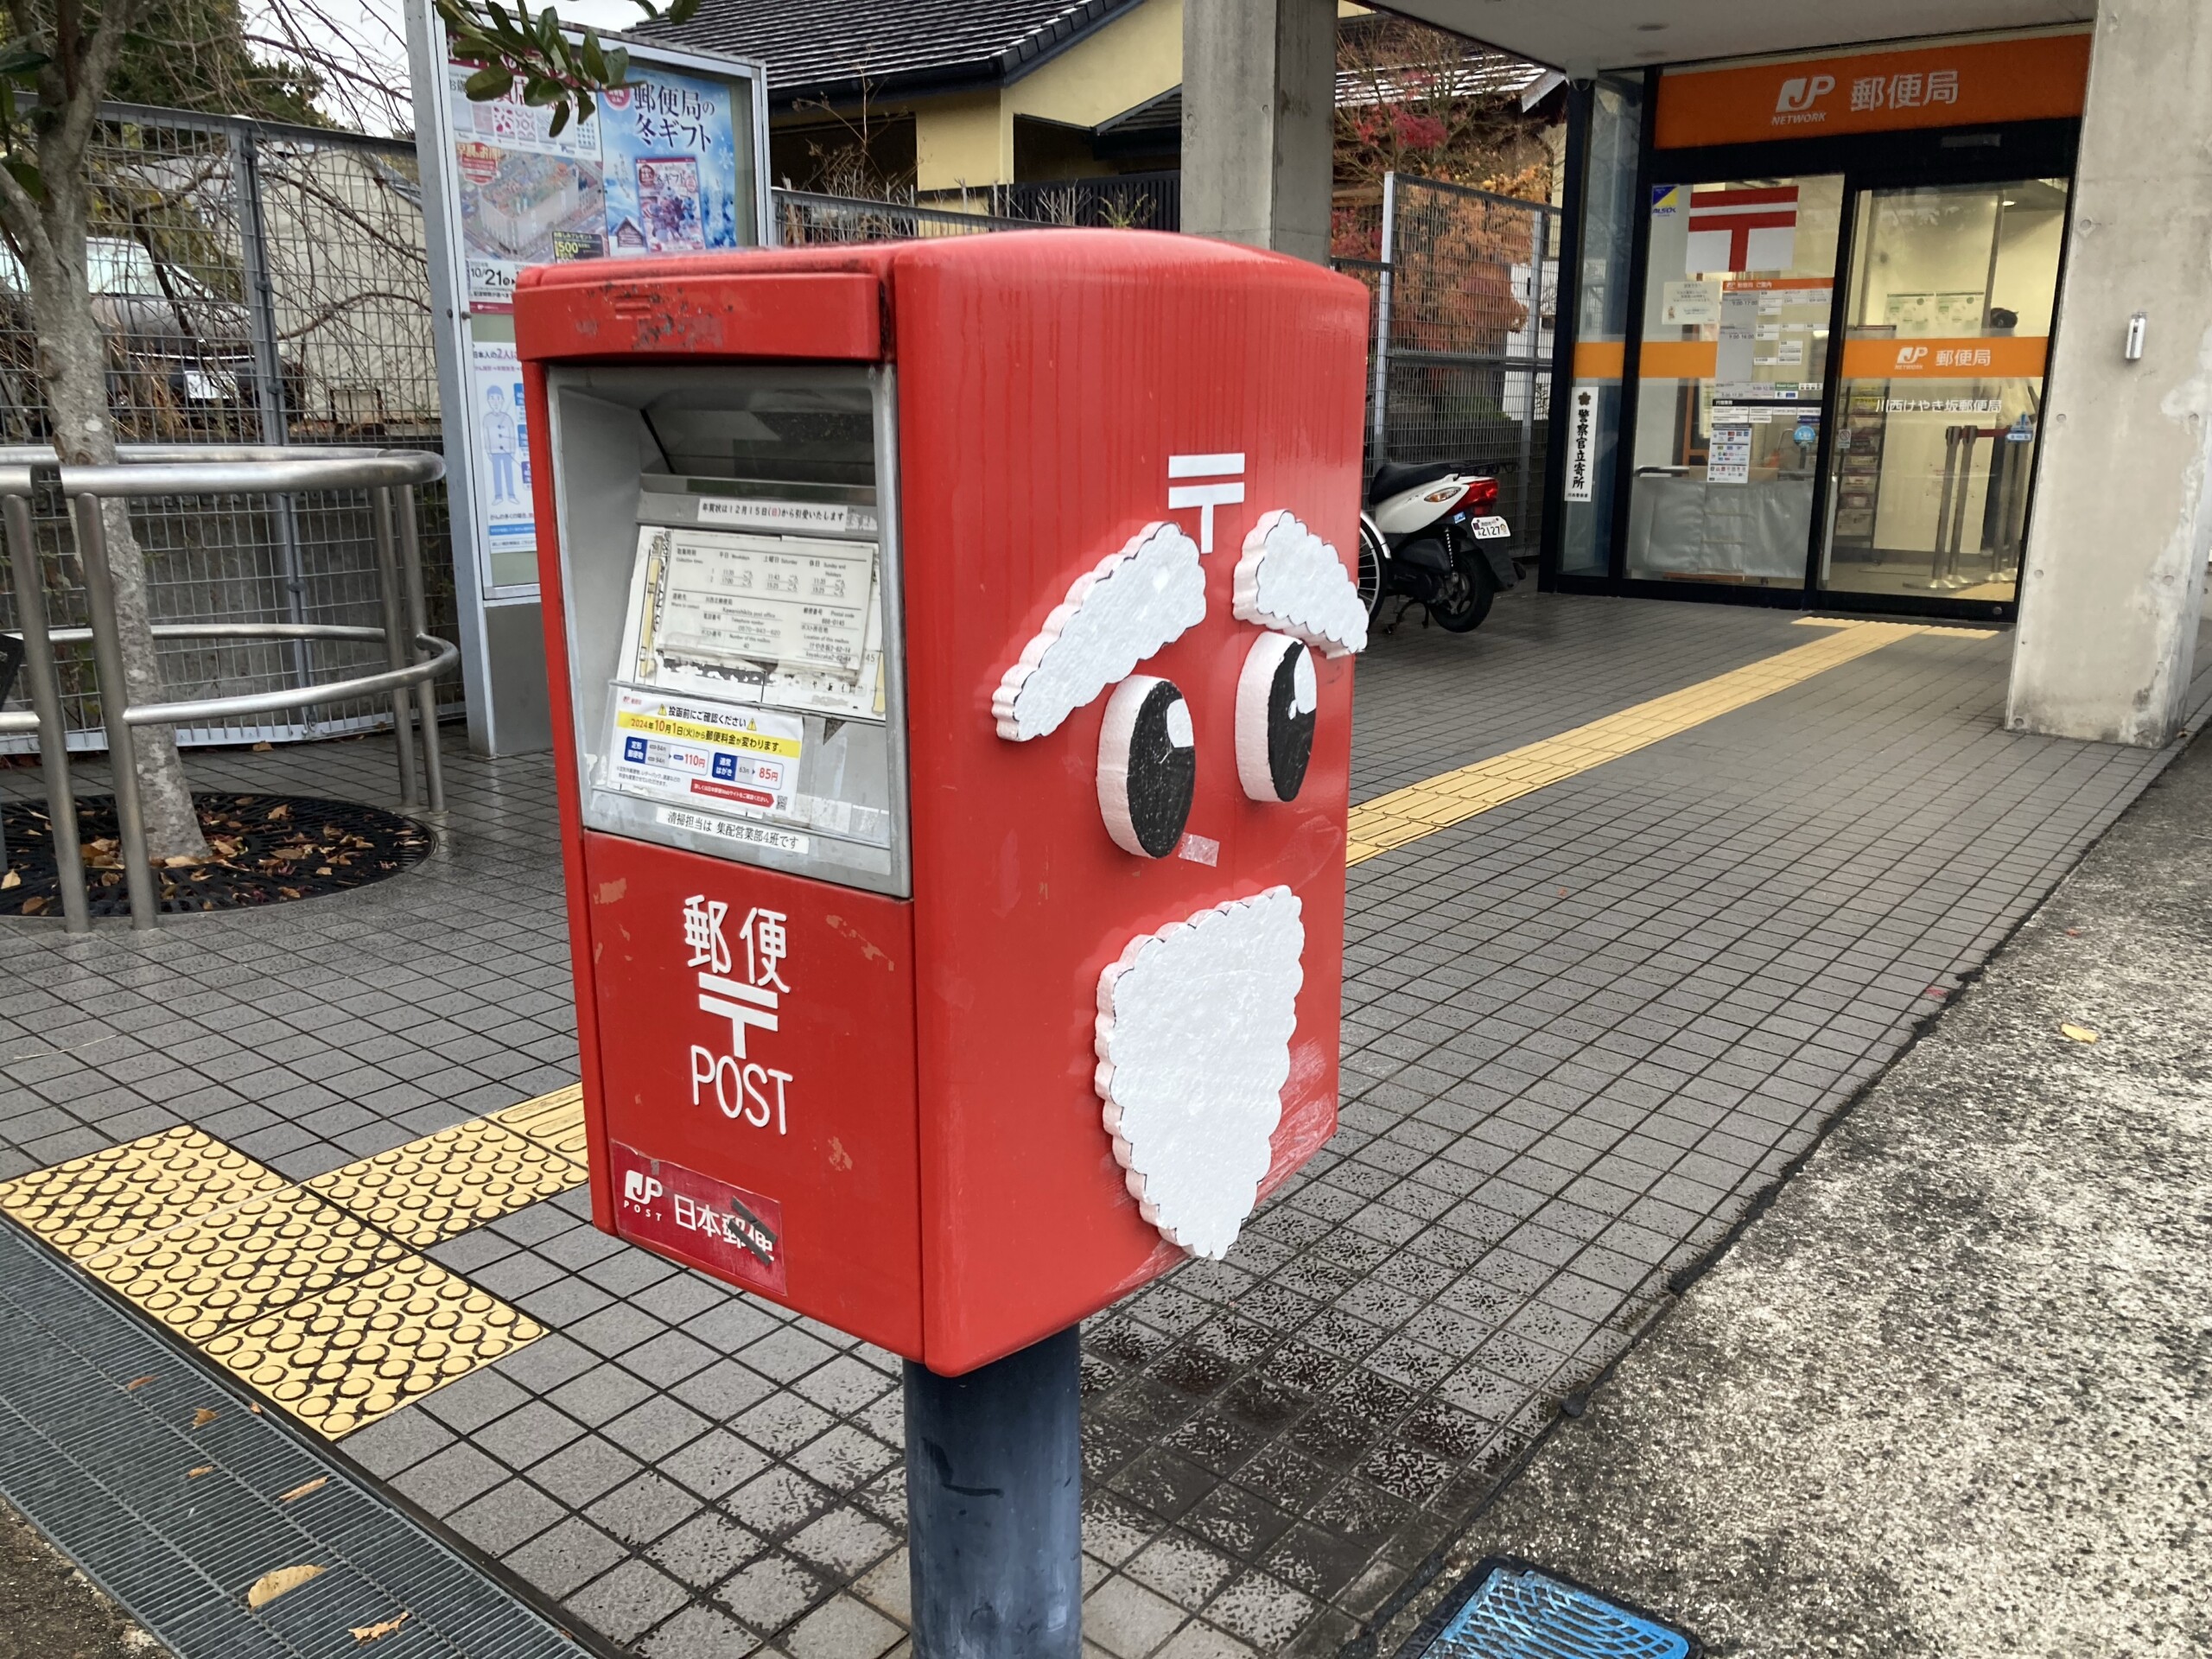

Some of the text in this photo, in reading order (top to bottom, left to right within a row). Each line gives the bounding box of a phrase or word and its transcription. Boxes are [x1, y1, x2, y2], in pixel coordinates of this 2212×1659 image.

[633, 84, 715, 120] 郵便局の
[1851, 70, 1959, 111] 郵便局
[1771, 112, 1827, 126] NETWORK
[636, 113, 711, 153] 冬ギフト
[1936, 349, 1991, 366] 郵便局
[1876, 399, 2002, 414] 川西けやき坂郵便局
[1572, 409, 1590, 490] 警察官立寄所
[668, 705, 747, 728] 投函前にご確認ください
[684, 753, 706, 769] 110円
[715, 766, 734, 777] はがき
[719, 756, 732, 766] 通常
[759, 766, 779, 783] 85円
[667, 810, 799, 850] 清掃担当は 集配営業部4班です
[683, 894, 791, 994] 郵便
[690, 1044, 793, 1135] POST
[623, 1199, 662, 1222] POST
